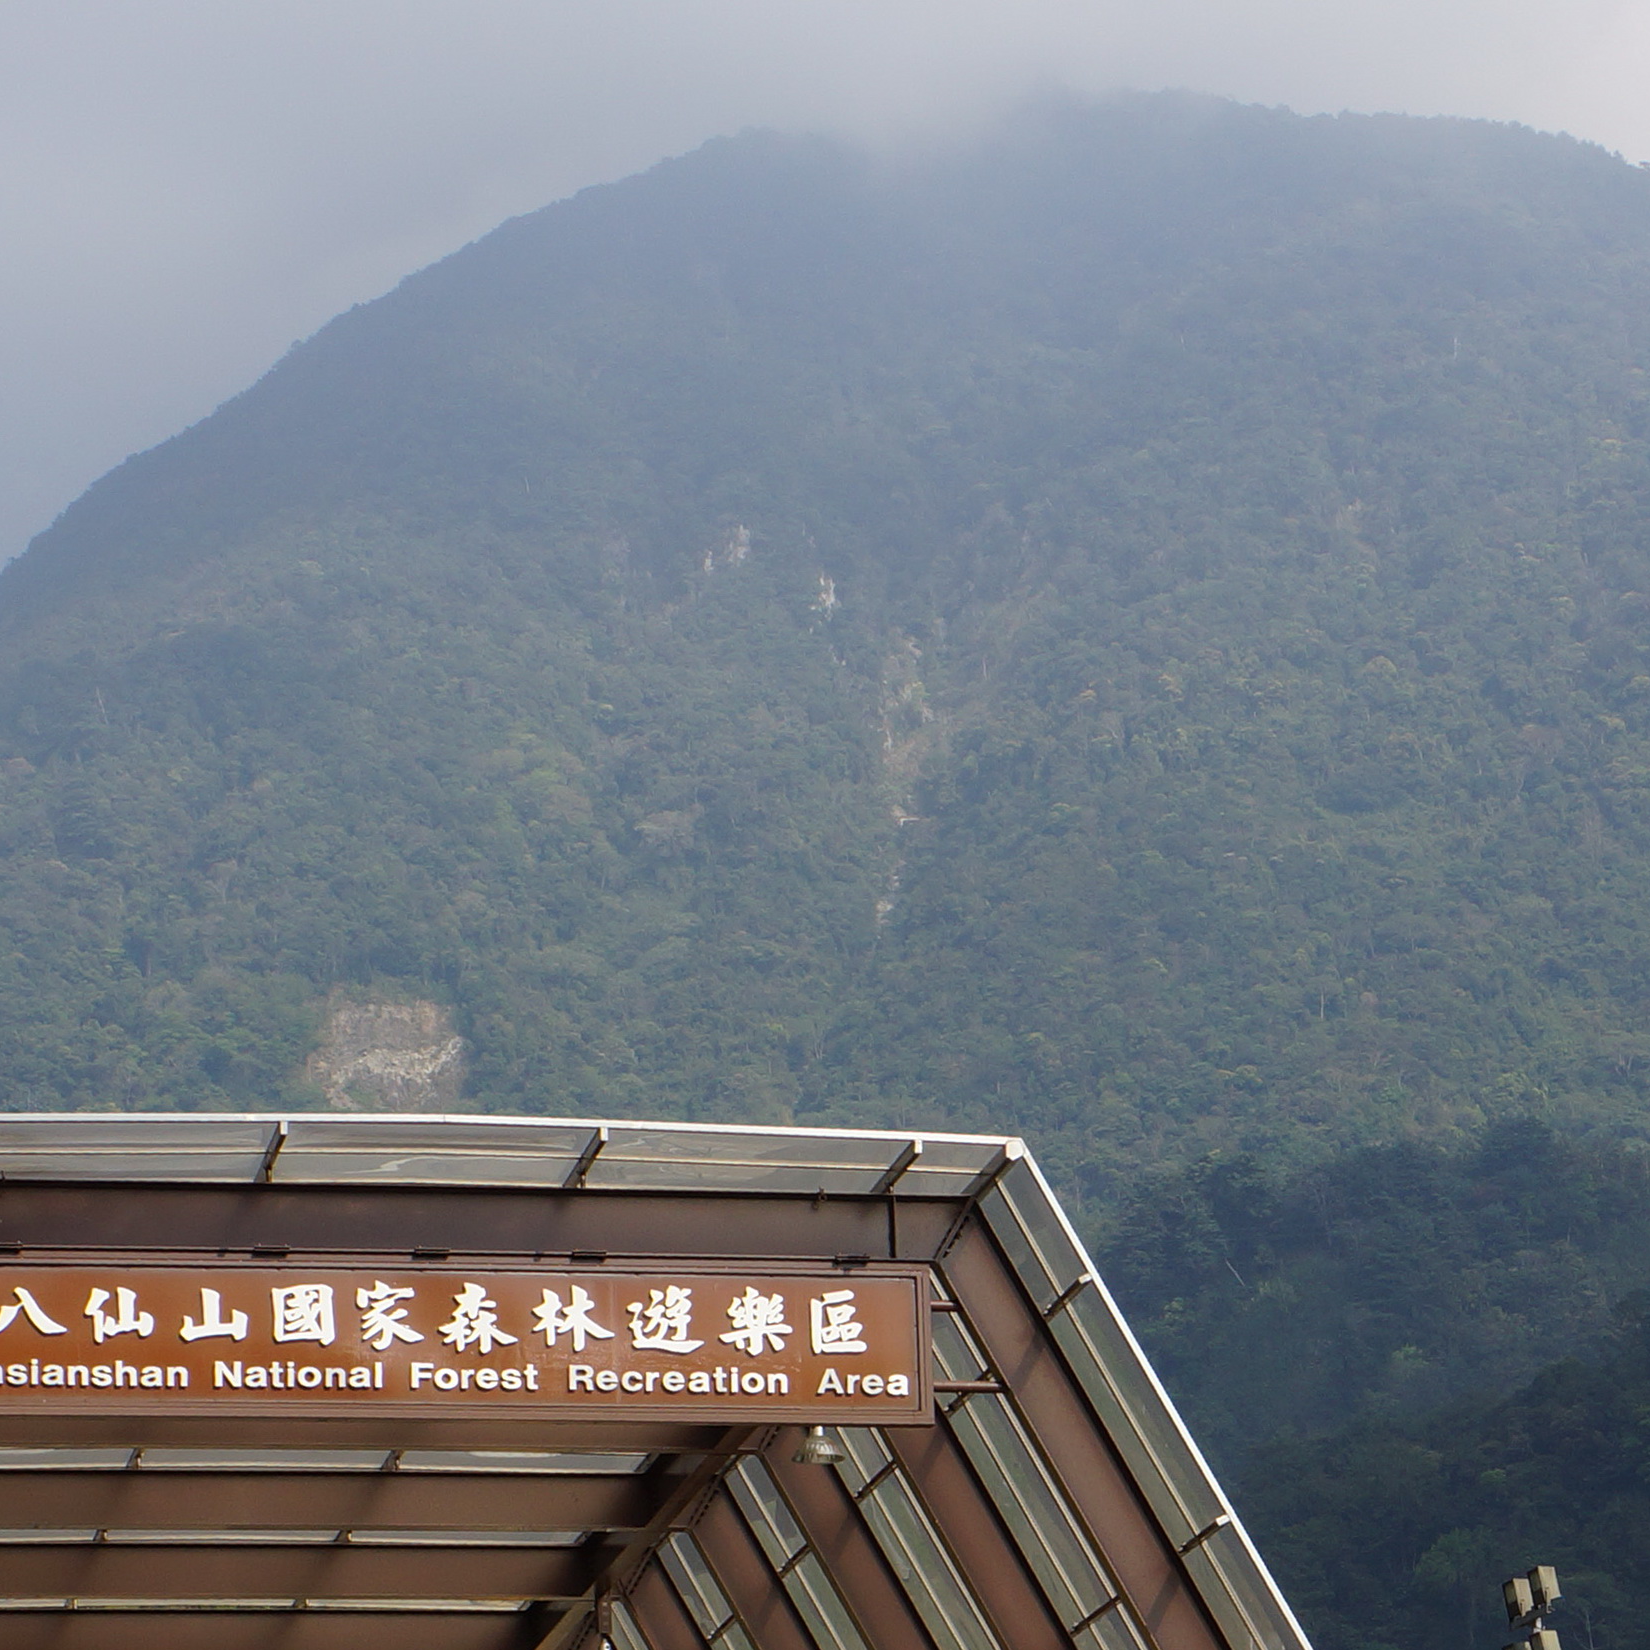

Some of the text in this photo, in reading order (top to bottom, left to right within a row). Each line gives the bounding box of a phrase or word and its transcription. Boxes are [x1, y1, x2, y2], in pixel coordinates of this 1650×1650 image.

[213, 1360, 384, 1390] National
[410, 1362, 539, 1391] Forest
[567, 1364, 789, 1395] Recreation
[816, 1367, 910, 1397] Area
